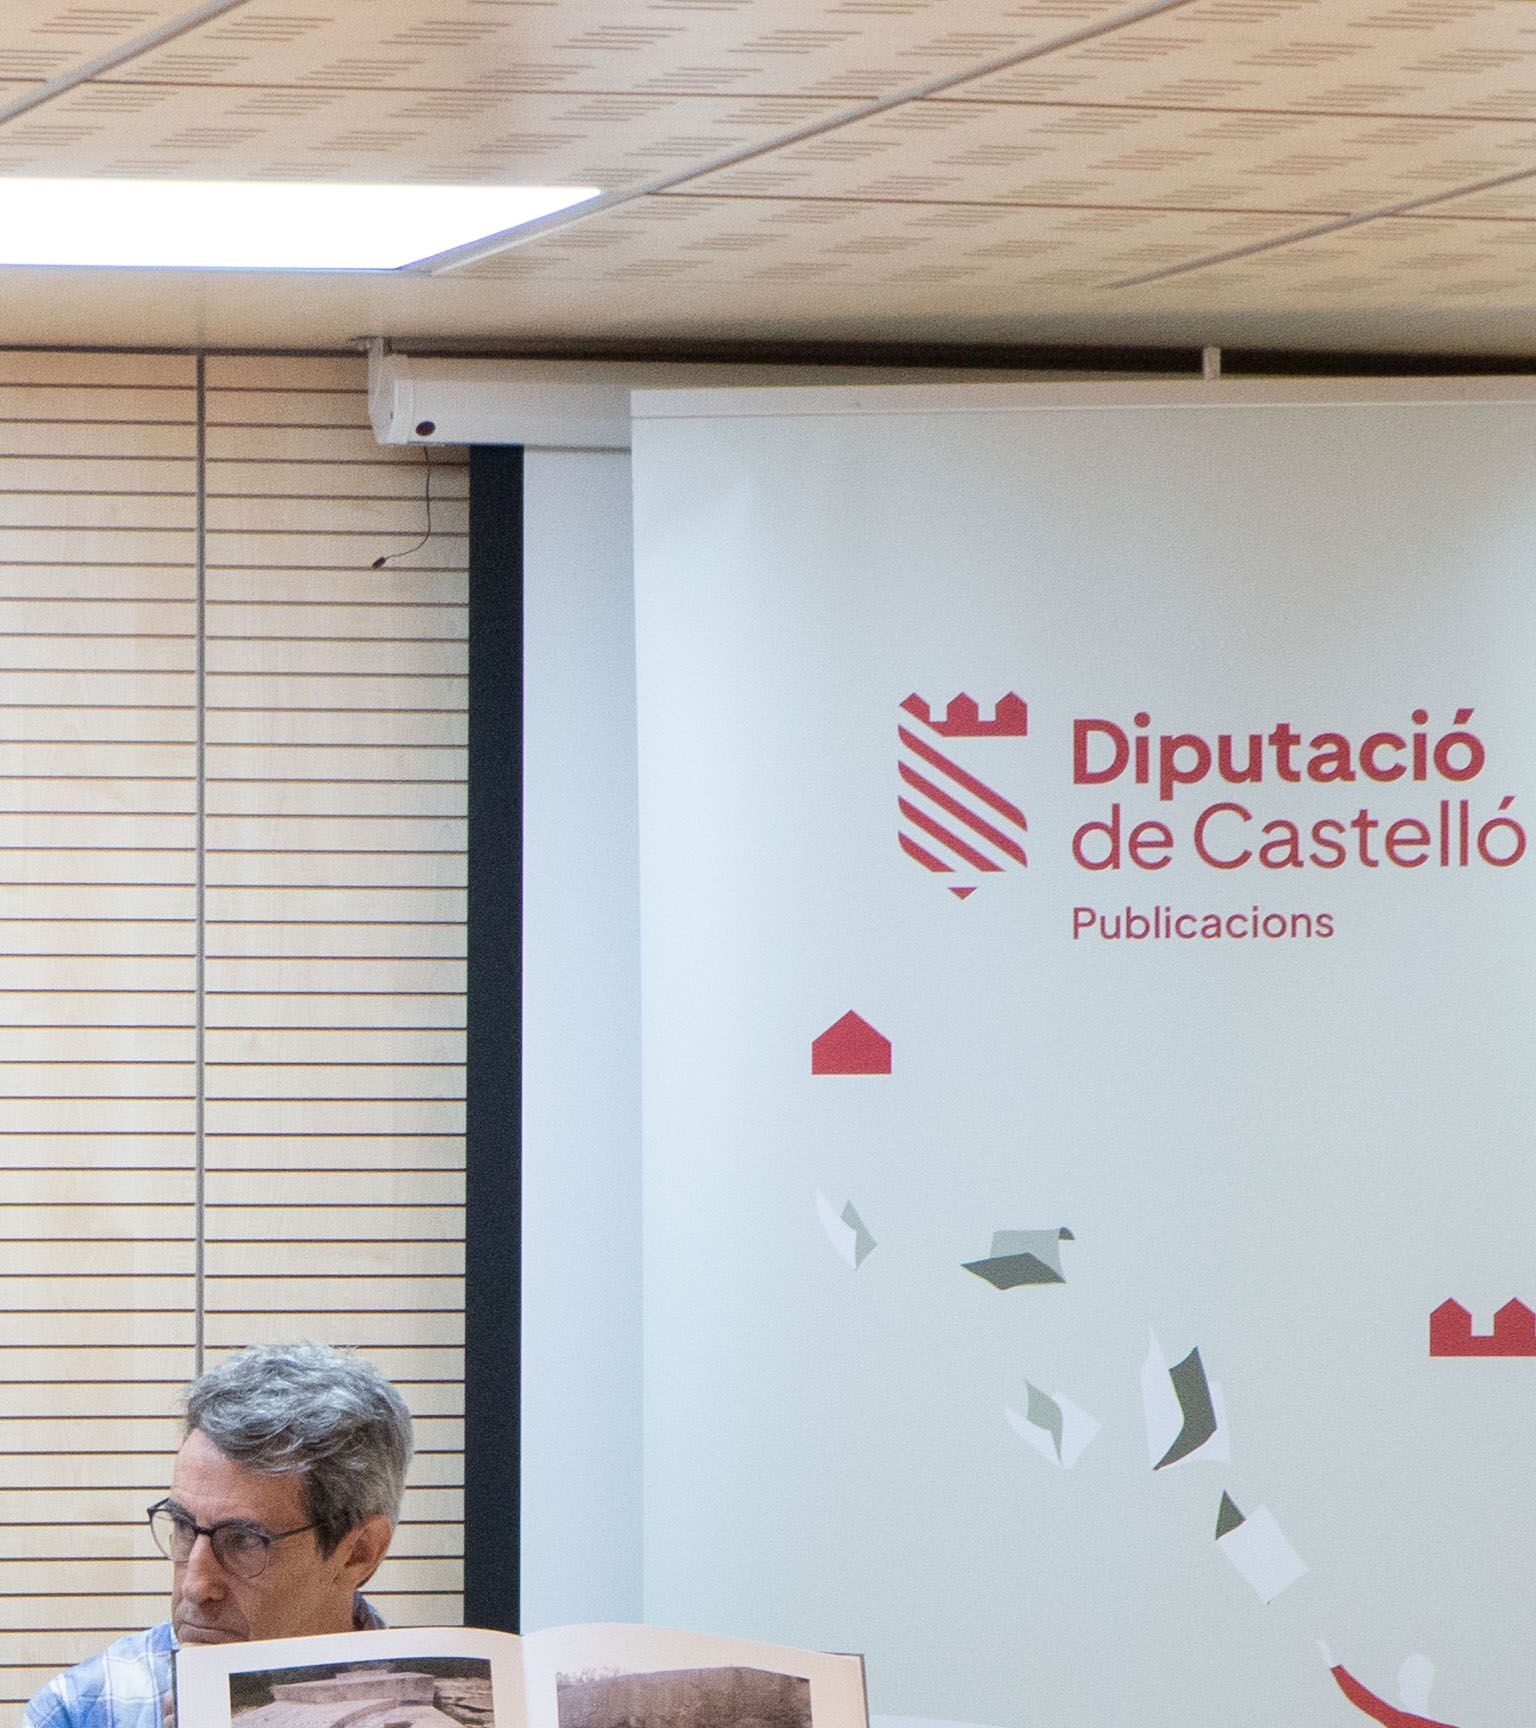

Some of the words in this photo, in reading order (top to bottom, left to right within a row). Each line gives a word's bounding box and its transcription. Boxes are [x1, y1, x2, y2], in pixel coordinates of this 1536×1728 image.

[1072, 707, 1486, 801] Diputació
[1072, 803, 1175, 871] de
[1193, 795, 1528, 870] Castelló
[1072, 905, 1335, 941] Publicacions
